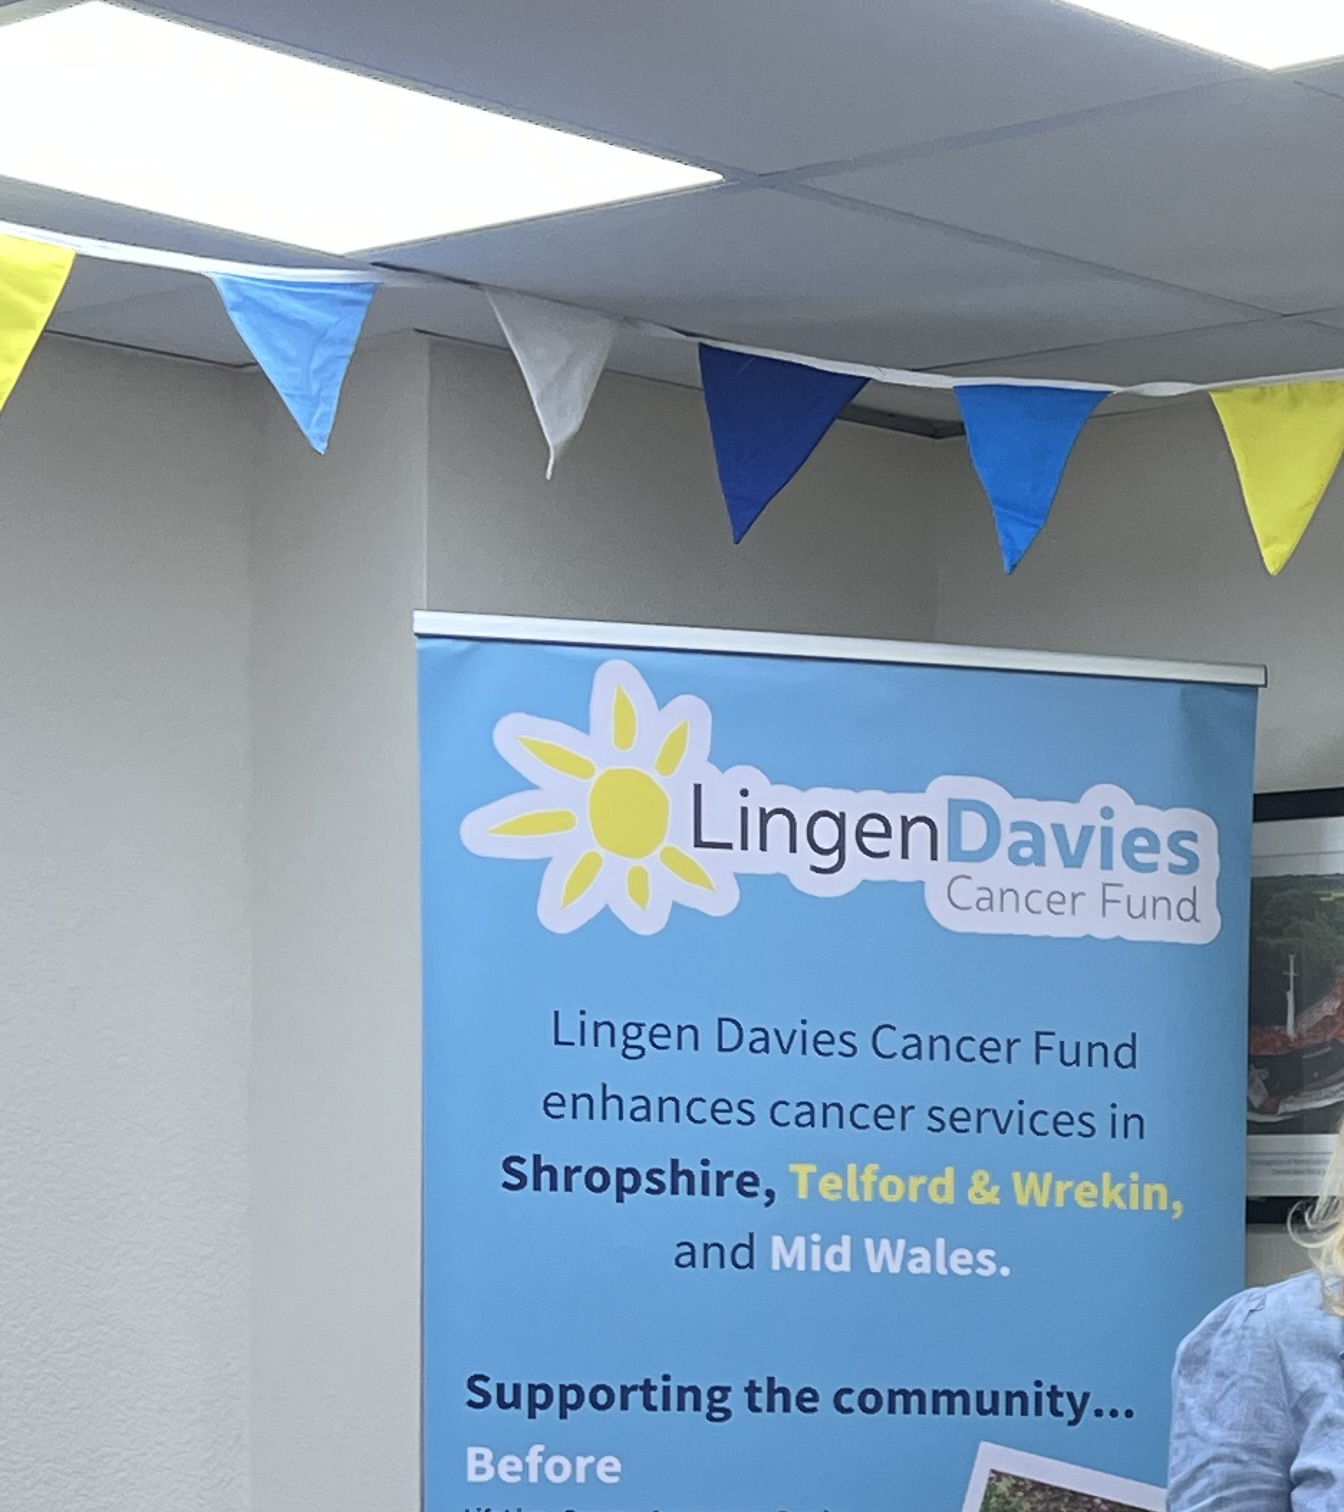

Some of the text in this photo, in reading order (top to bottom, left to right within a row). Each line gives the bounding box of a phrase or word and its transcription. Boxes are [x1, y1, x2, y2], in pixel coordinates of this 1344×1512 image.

[947, 875, 1201, 923] Cancer Fund
[554, 1010, 1136, 1069] Lingen Davies Cancer Fund
[543, 1083, 1144, 1139] enhances cancer services in
[502, 1154, 1182, 1218] Shropshire, Telford & Wrekin,
[675, 1232, 1010, 1276] and Mid Wales.
[467, 1374, 1134, 1426] Supporting the community...
[467, 1445, 621, 1483] Before
